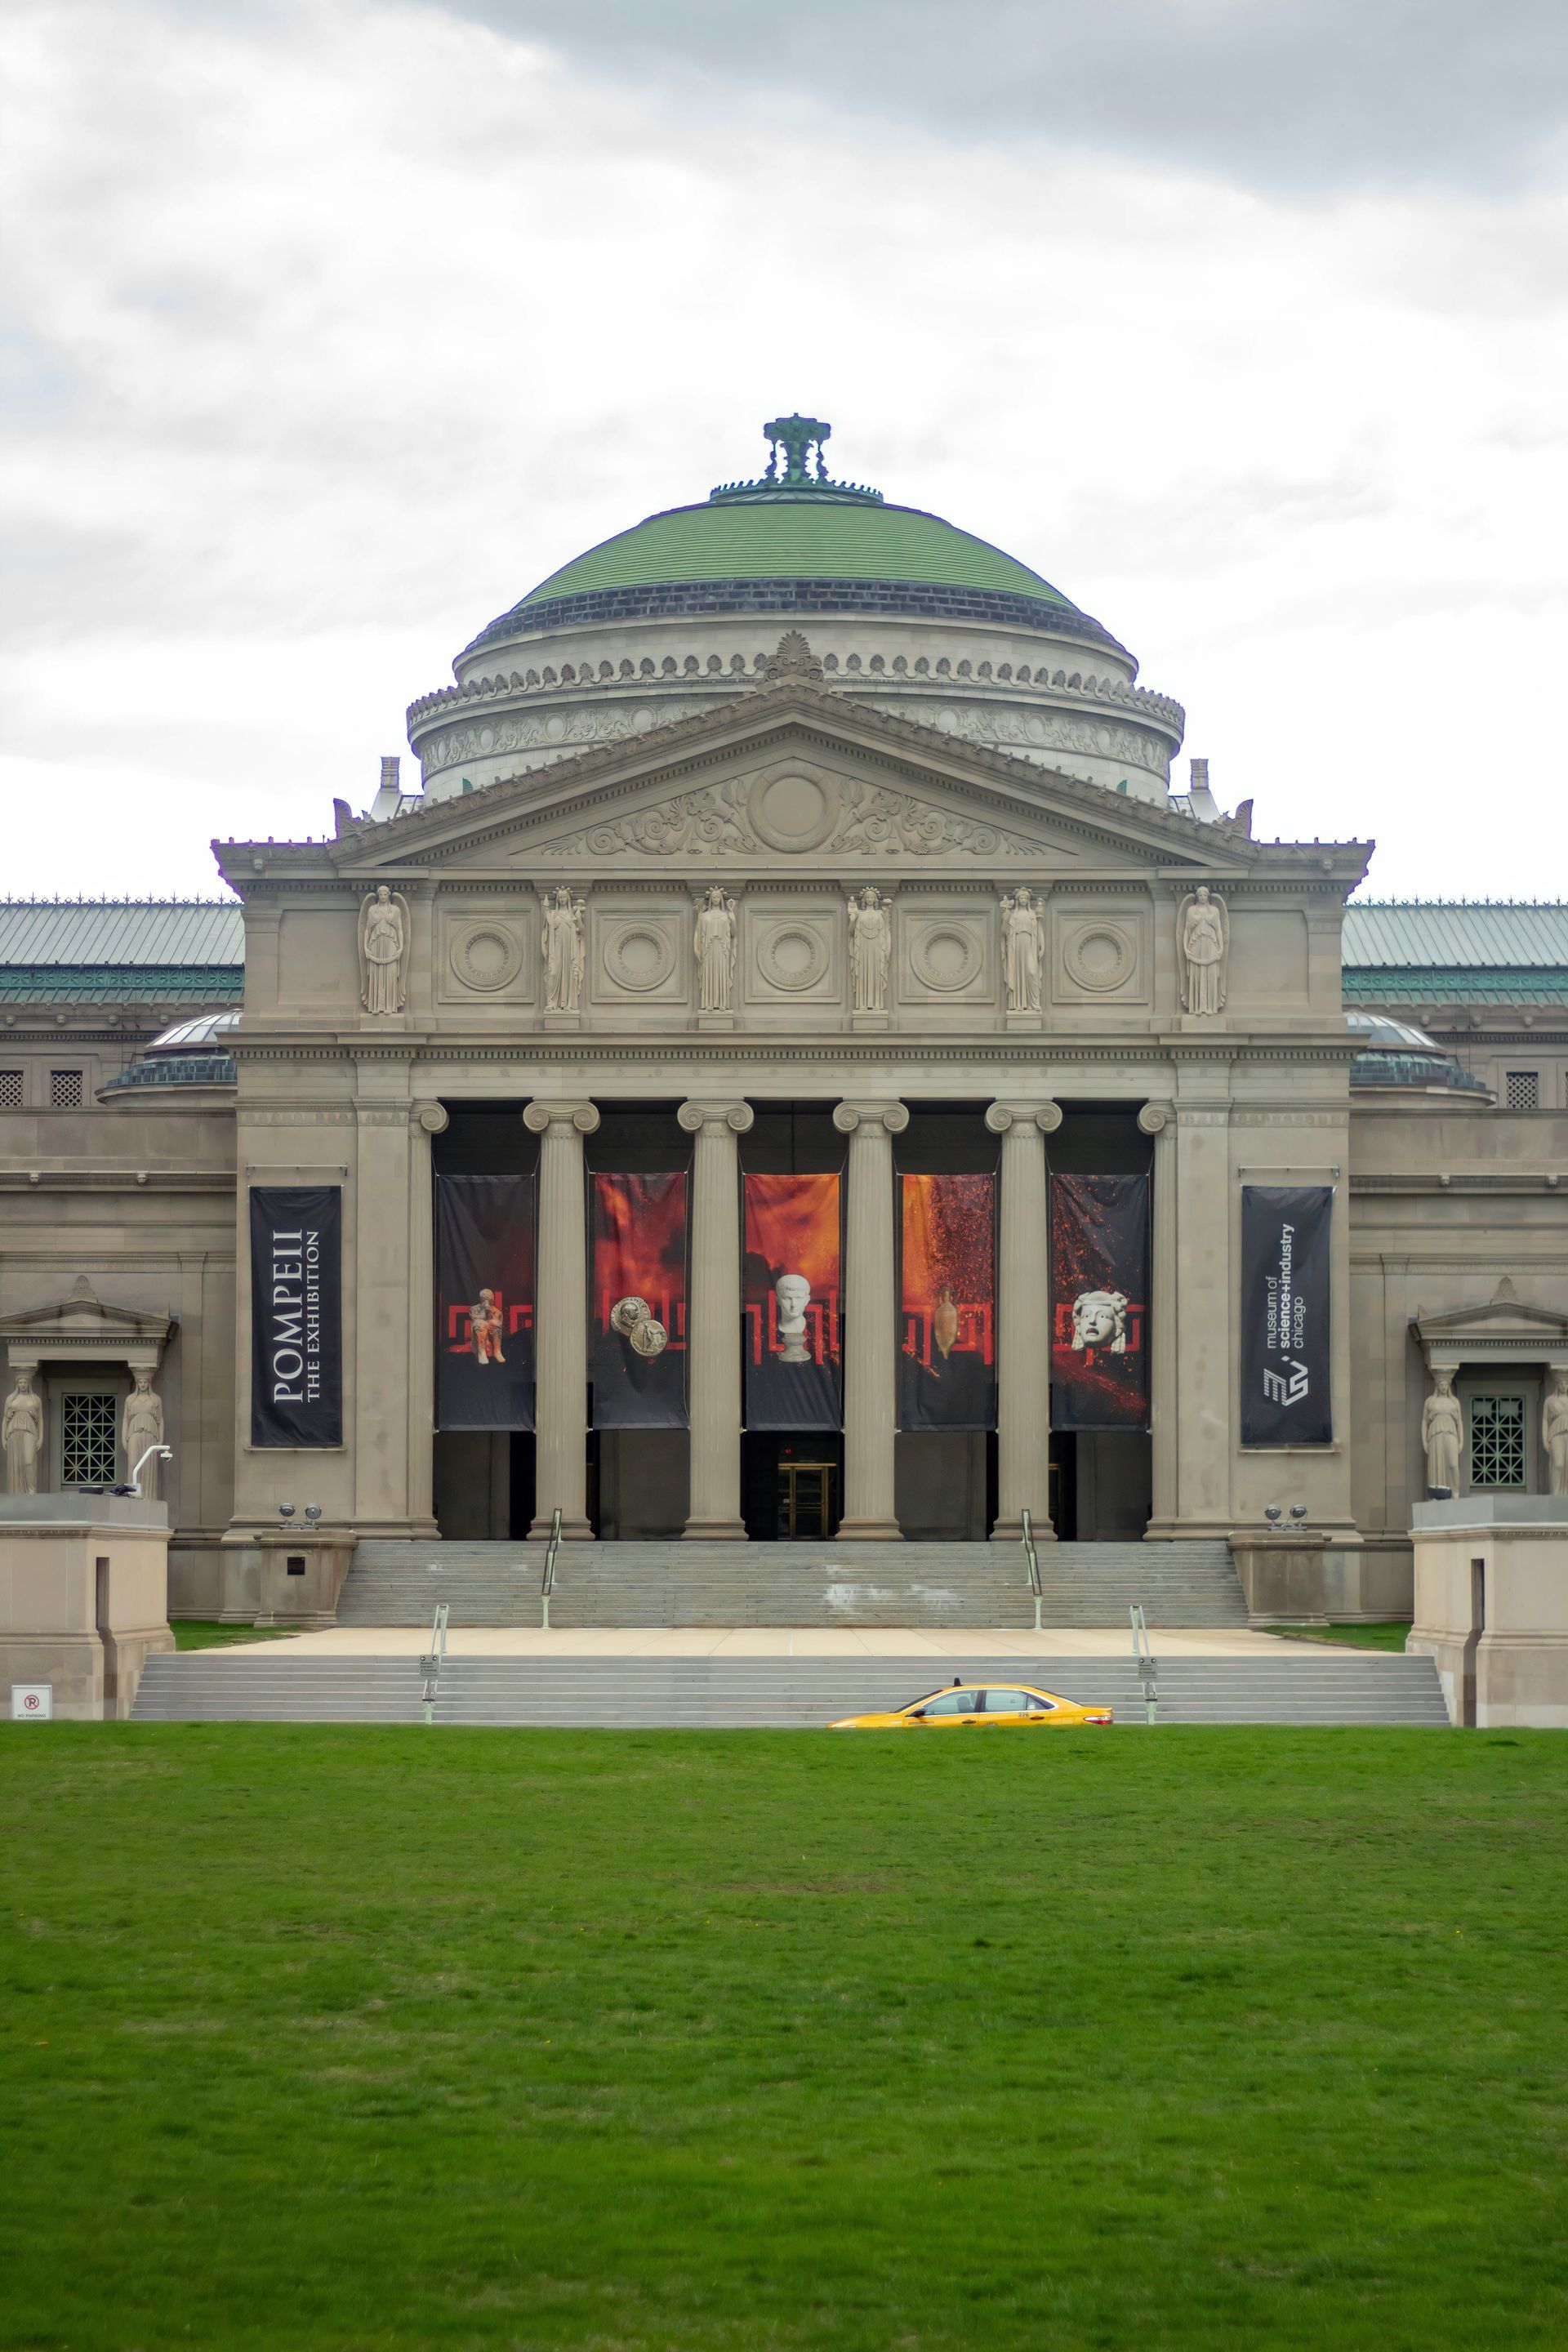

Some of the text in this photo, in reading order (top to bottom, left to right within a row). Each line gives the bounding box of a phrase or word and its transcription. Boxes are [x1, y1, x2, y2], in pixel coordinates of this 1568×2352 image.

[273, 1228, 303, 1404] POMPEII
[306, 1231, 320, 1403] THE EXHIBITION
[1266, 1276, 1278, 1349] museum of
[1278, 1223, 1295, 1349] science+industry
[1291, 1297, 1306, 1349] chicago
